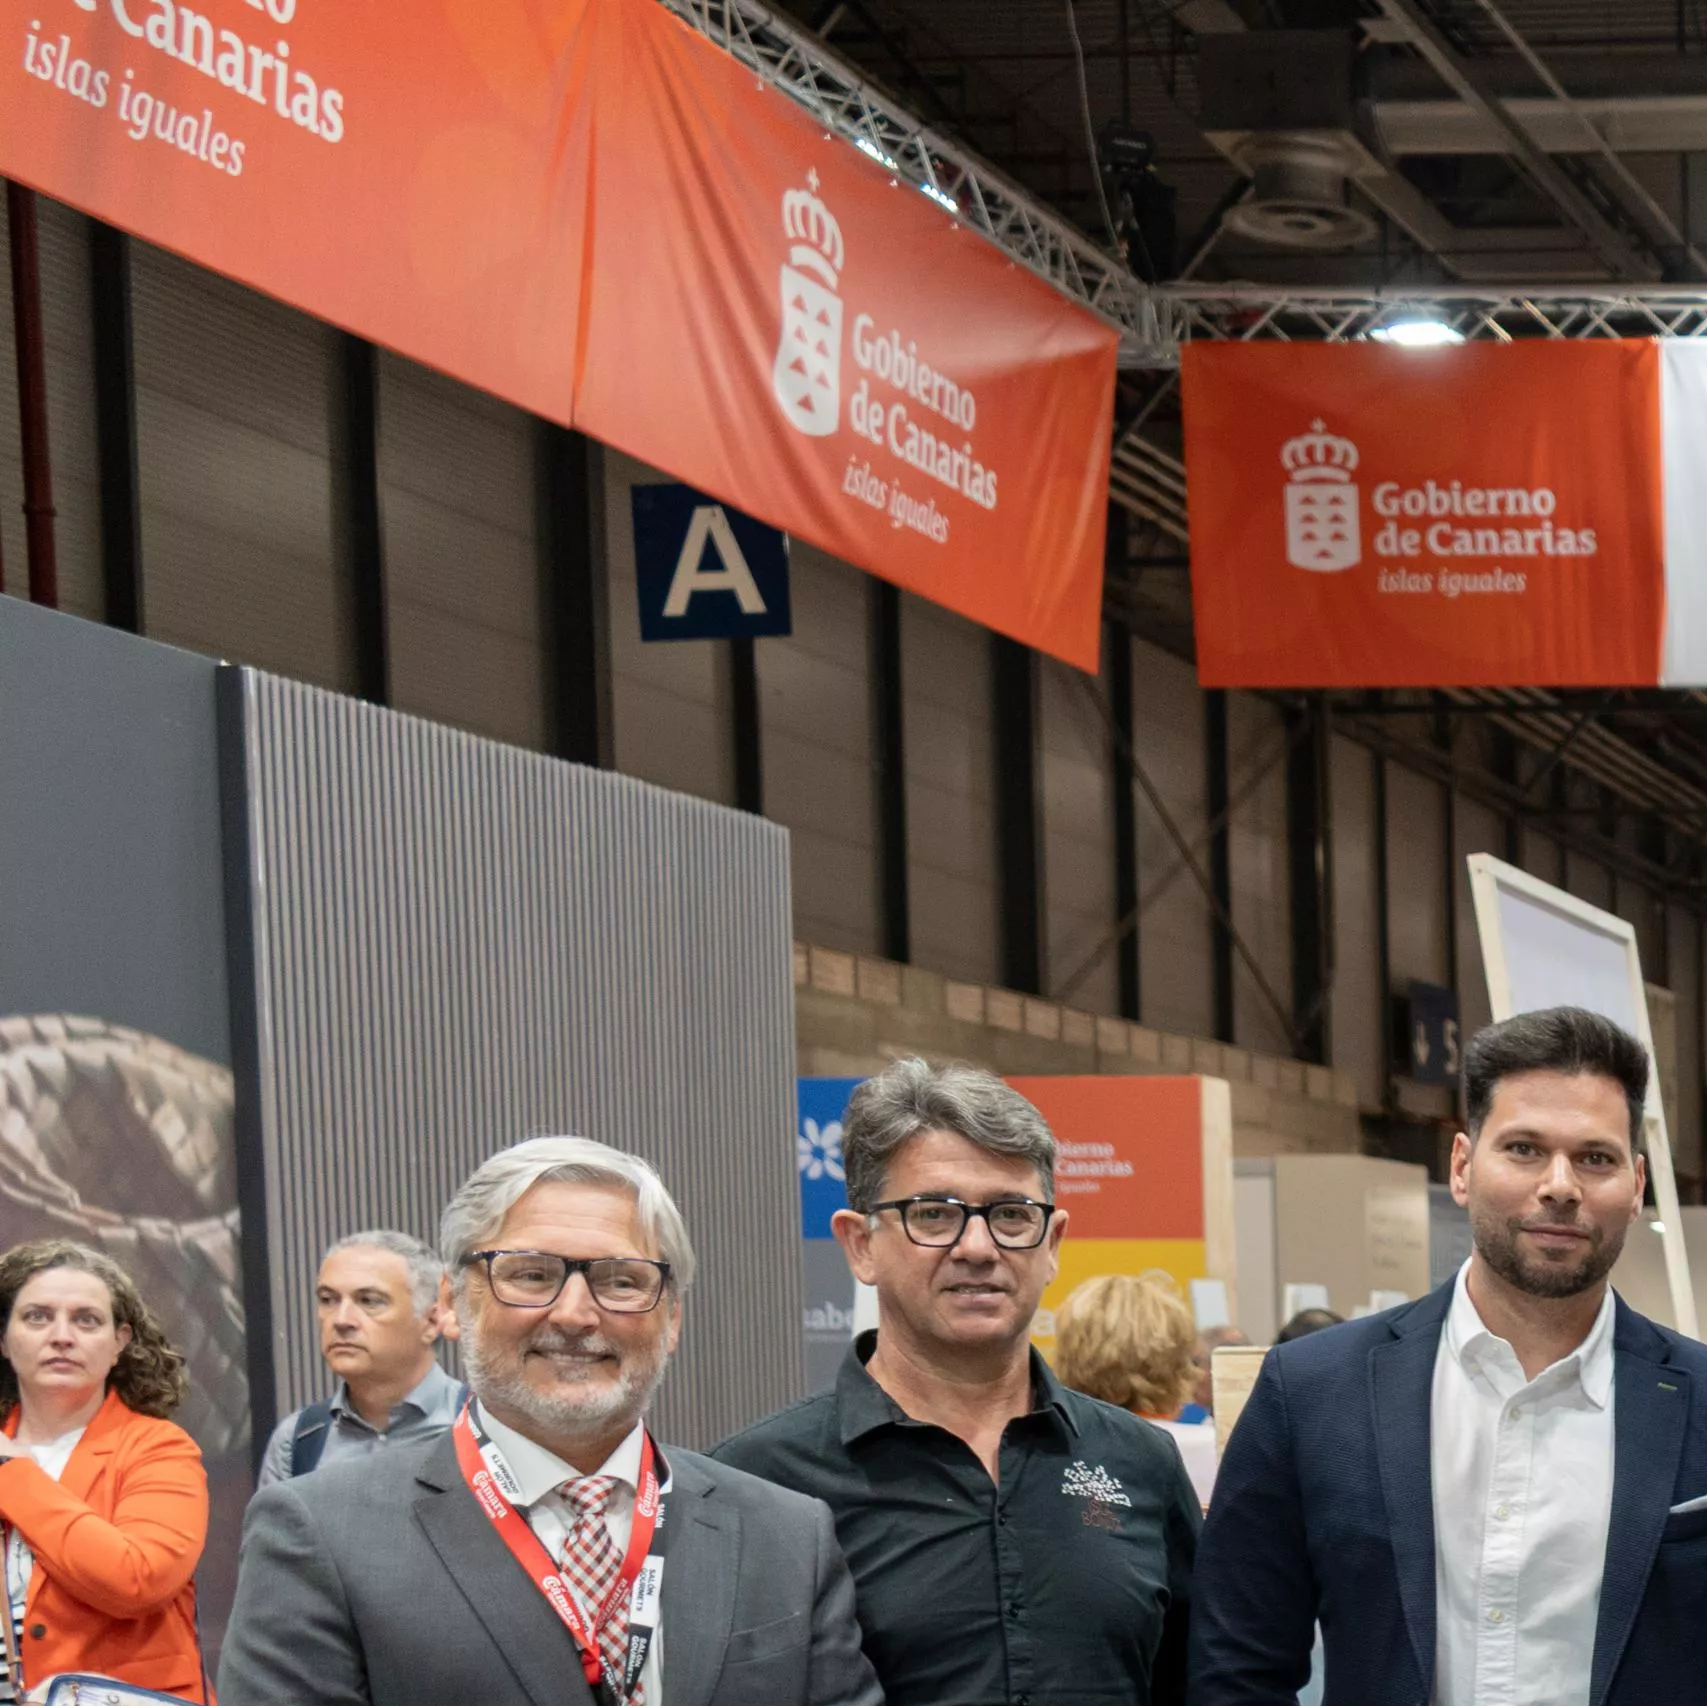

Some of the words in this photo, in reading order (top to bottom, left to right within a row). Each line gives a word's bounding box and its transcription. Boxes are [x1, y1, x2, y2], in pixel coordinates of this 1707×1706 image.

[24, 19, 110, 108] islas
[119, 68, 246, 177] iguales
[852, 312, 976, 433] Gobierno
[851, 378, 884, 446] de
[888, 402, 998, 511] Canarias
[842, 452, 887, 510] islas
[888, 477, 949, 545] iguales
[1373, 480, 1557, 518] Gobierno
[1374, 519, 1421, 557] de
[1426, 519, 1598, 557] Canarias
[662, 505, 767, 617] A
[1378, 566, 1433, 594] islas
[1437, 564, 1527, 600] iguales
